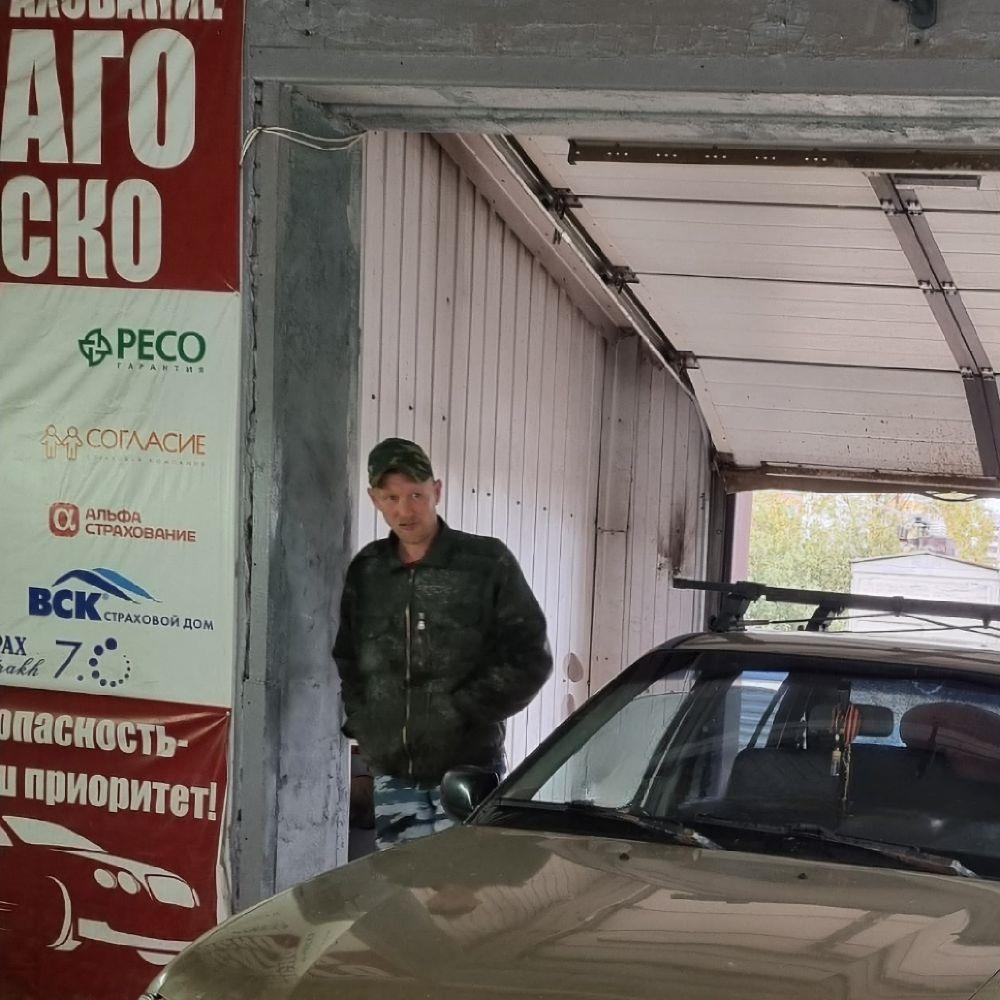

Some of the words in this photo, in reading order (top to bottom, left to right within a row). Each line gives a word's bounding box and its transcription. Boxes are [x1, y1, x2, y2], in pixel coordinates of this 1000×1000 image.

[1, 175, 162, 283] СКО
[117, 328, 206, 363] РЕСО
[86, 428, 206, 455] СОГЛАСИЕ
[85, 508, 142, 523] АЛЬФА
[85, 523, 196, 542] СТРАХОВАНИЕ
[28, 586, 102, 621] ВСК
[103, 611, 180, 628] СТРАХОВОЙ
[182, 618, 214, 631] ДОМ
[24, 767, 217, 821] приоритет!
